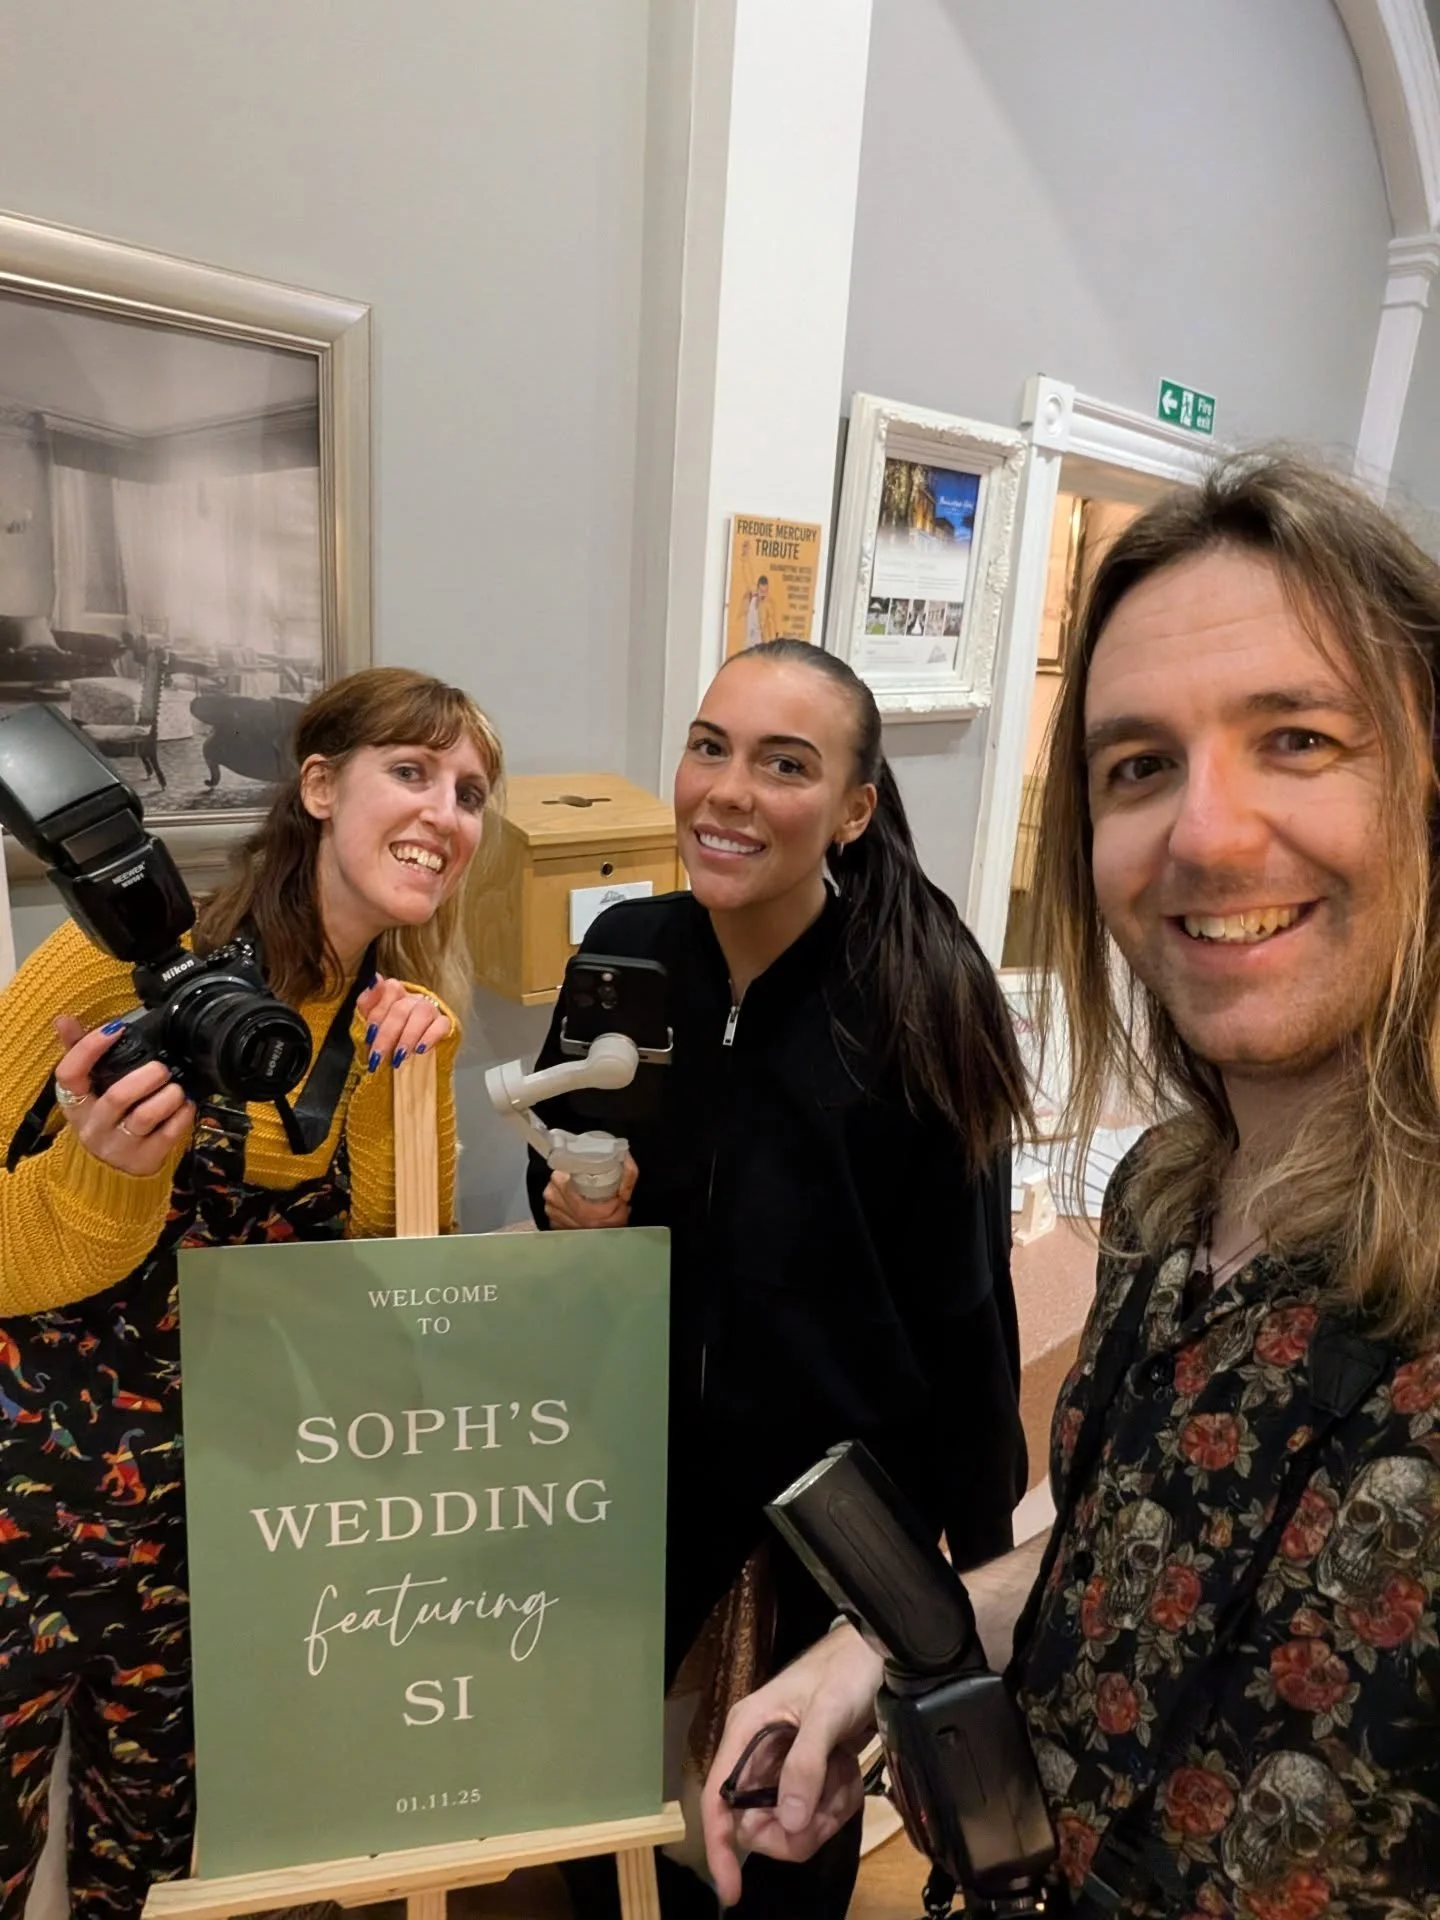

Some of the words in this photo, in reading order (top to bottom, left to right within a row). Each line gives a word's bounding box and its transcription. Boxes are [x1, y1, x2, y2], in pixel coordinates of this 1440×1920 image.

[1198, 397, 1212, 416] Fire
[1196, 415, 1211, 430] exit
[737, 519, 773, 538] FREDDIE
[775, 523, 817, 543] MERCURY
[755, 538, 800, 560] TRIBUTE
[161, 959, 195, 982] Nikon
[266, 1040, 285, 1077] Nikon
[367, 1284, 499, 1309] WELCOME
[416, 1316, 451, 1336] TO
[295, 1399, 570, 1465] SOPH'S
[249, 1478, 613, 1553] WEDDING
[303, 1572, 560, 1676] featuring
[402, 1675, 475, 1727] SI
[395, 1788, 482, 1814] 01.11.25
